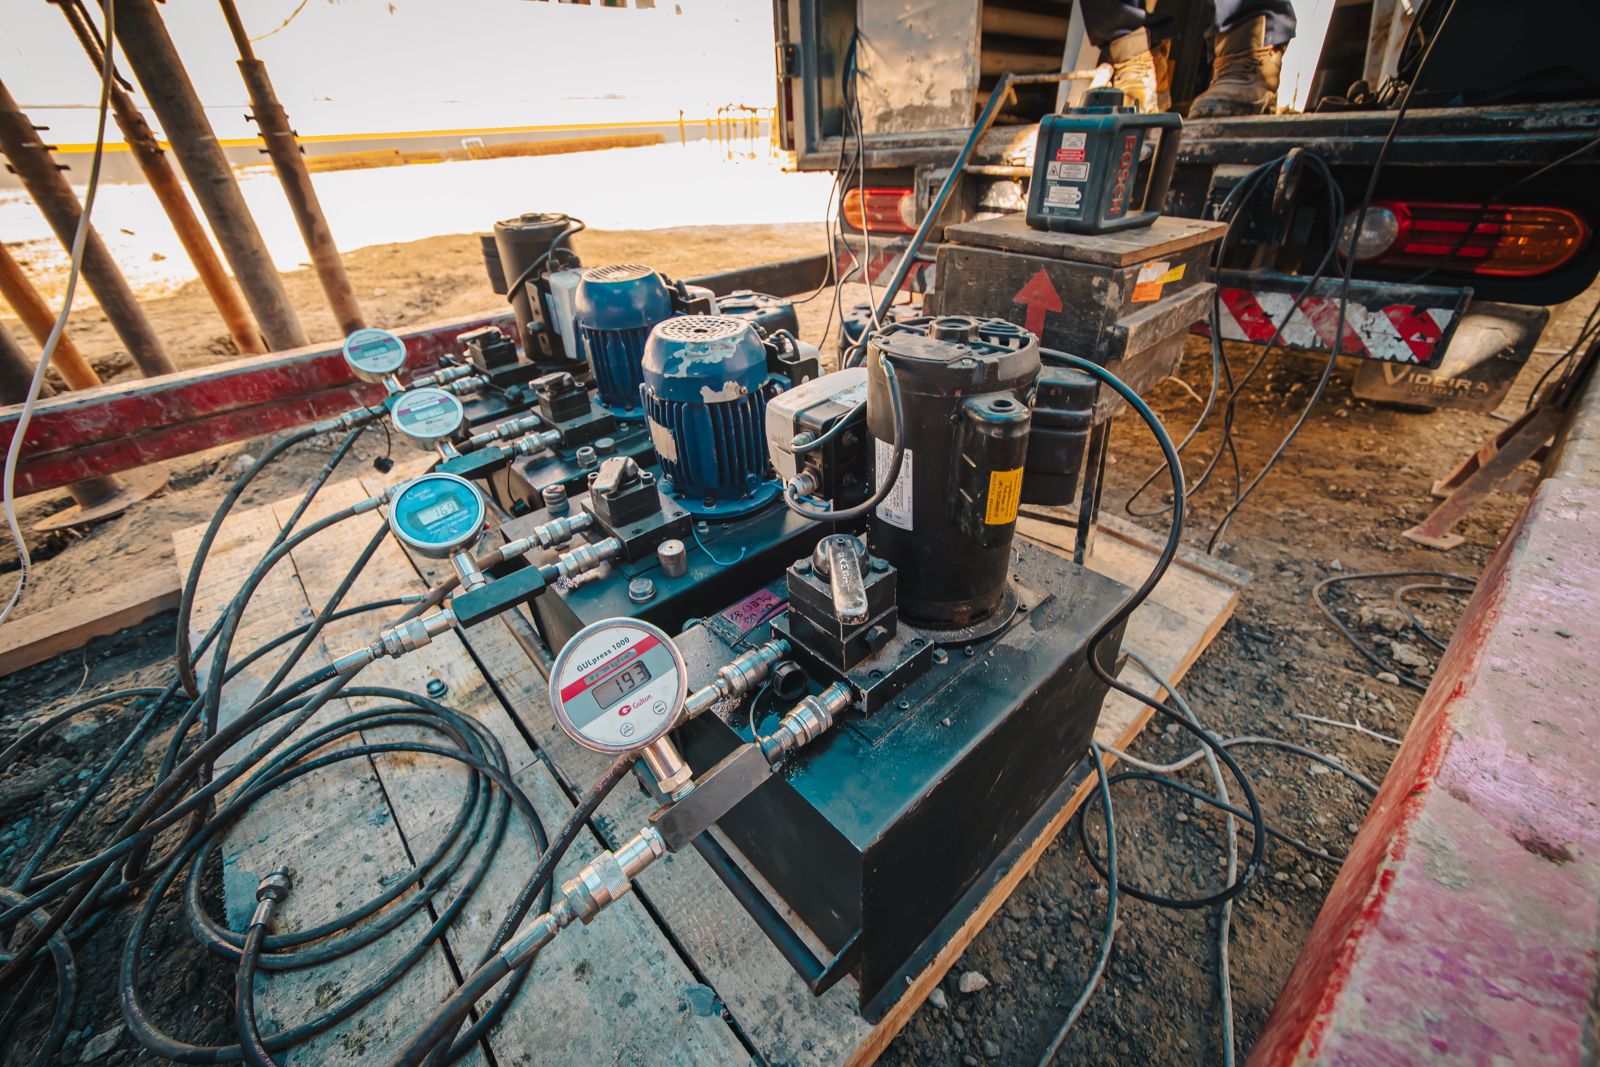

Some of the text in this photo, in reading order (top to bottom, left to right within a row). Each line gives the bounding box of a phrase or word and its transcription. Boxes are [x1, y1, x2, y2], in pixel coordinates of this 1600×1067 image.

[1110, 135, 1137, 216] BOSCH
[1382, 362, 1489, 394] VIDEIRA
[576, 636, 630, 672] GULpress 1000
[616, 663, 645, 693] 193
[632, 694, 653, 709] Gulton
